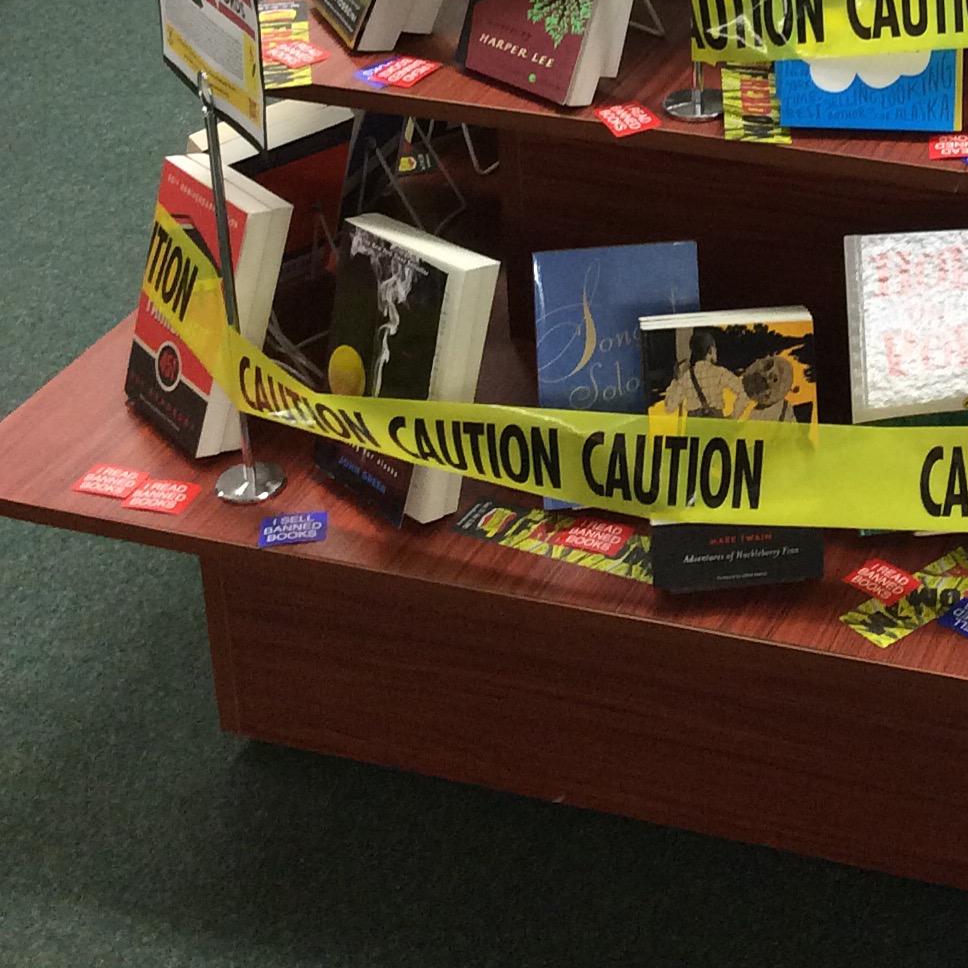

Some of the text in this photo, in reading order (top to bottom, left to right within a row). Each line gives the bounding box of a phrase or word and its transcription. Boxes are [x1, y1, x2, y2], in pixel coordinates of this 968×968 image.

[478, 33, 555, 69] HARPER LEE
[239, 356, 381, 448] CAUTION
[388, 416, 562, 489] CAUTION
[581, 430, 764, 510] CAUTION
[84, 474, 136, 490] BANNED
[106, 470, 138, 480] READ
[87, 482, 125, 495] BOOKS
[132, 487, 187, 503] BANNED
[153, 483, 188, 494] READ
[137, 496, 178, 511] BOOKS
[262, 520, 322, 534] BANNED
[282, 514, 315, 525] SELL
[588, 520, 623, 535] READ
[265, 529, 318, 543] BOOKS
[565, 535, 612, 551] BOOKS
[569, 527, 622, 544] BANNED
[740, 532, 772, 542] TWAIN
[682, 545, 800, 564] Adventures of Huckleberry Finn
[857, 567, 905, 596] BANNED
[878, 565, 910, 586] READ
[851, 575, 891, 600] BOOKS
